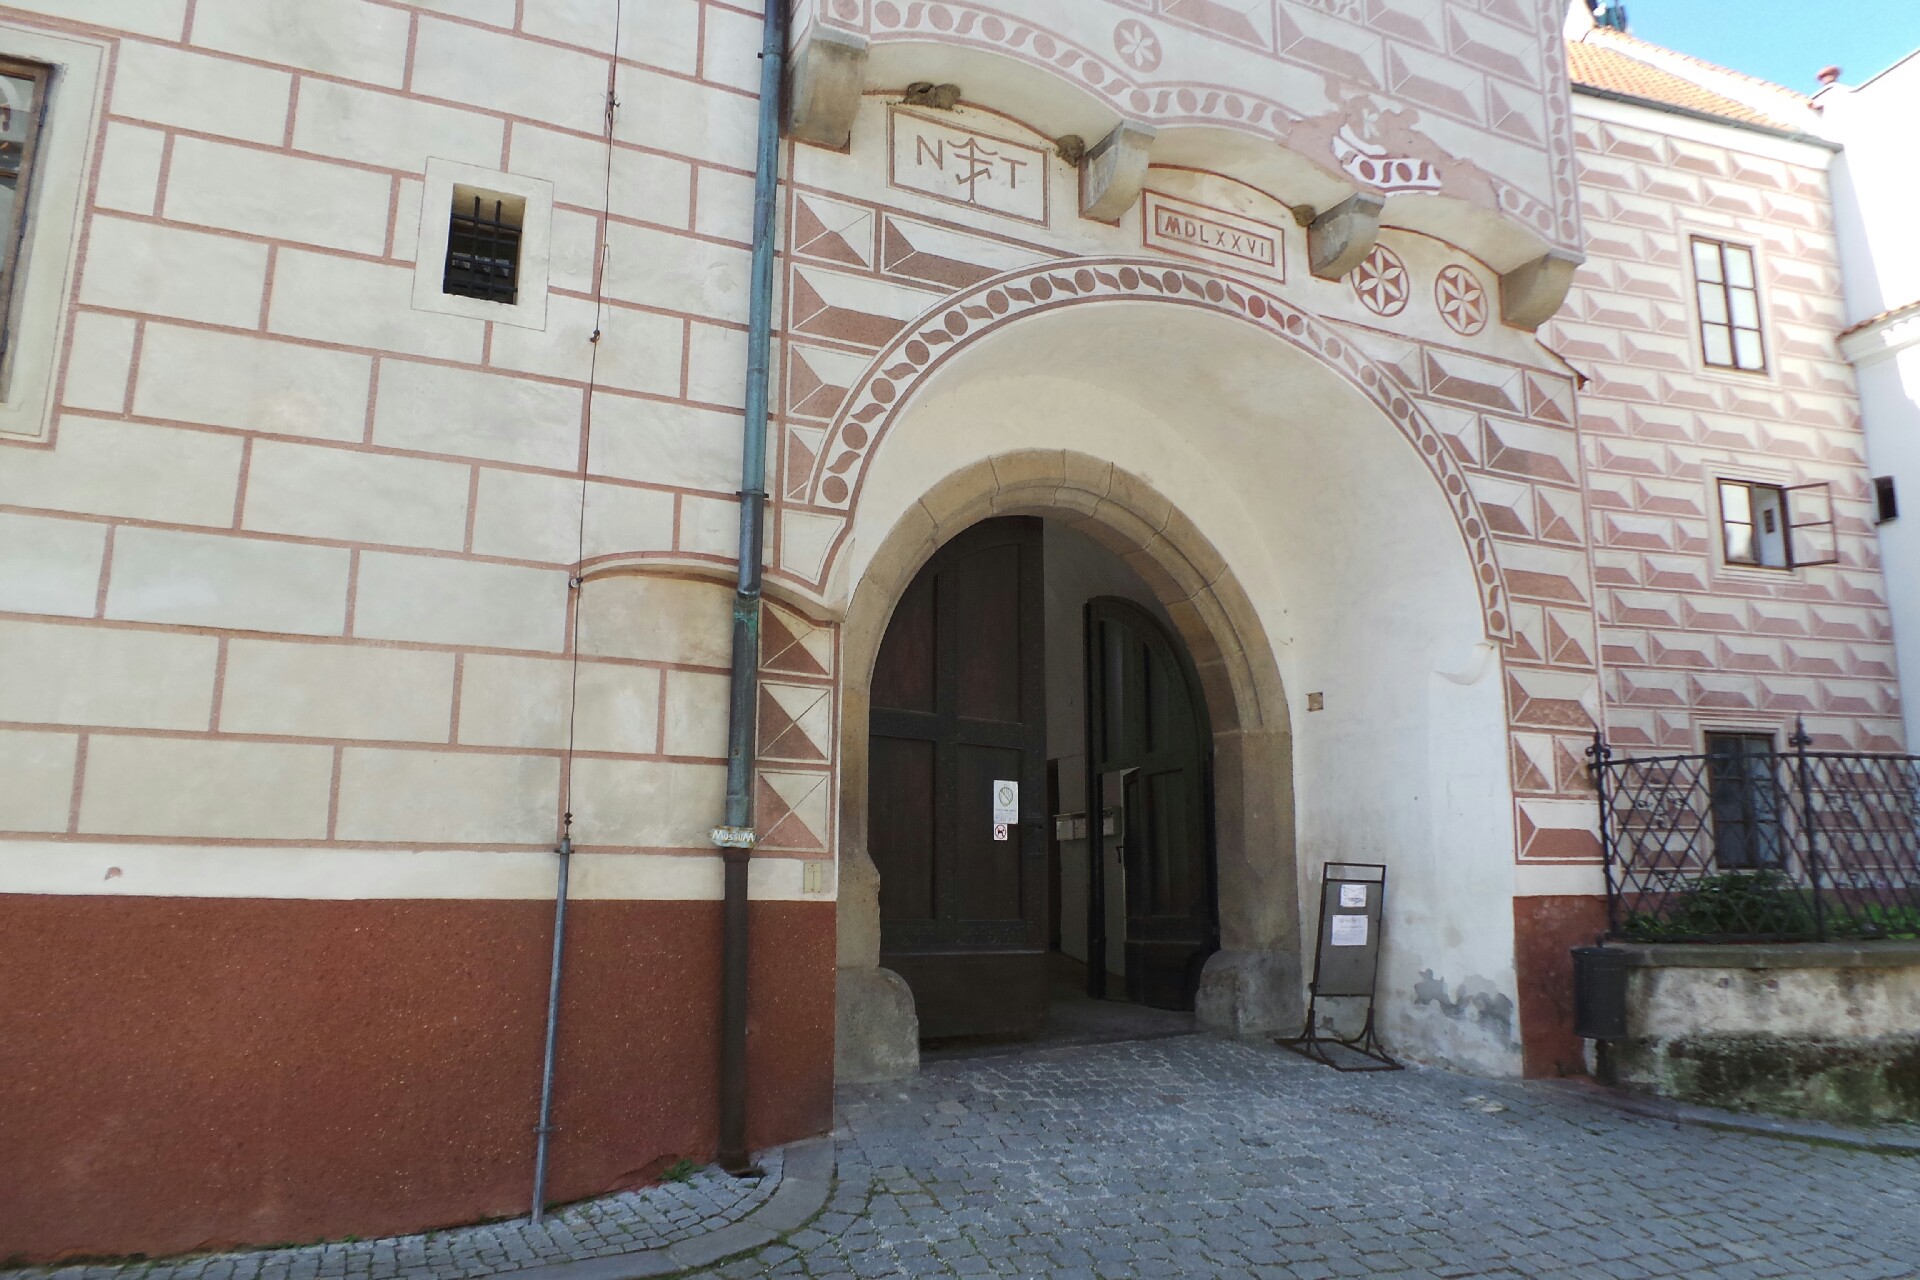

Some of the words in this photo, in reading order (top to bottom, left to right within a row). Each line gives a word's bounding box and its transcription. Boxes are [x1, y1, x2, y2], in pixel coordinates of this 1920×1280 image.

[916, 134, 943, 170] N
[999, 156, 1027, 189] T
[1164, 215, 1264, 257] MDLXXVI
